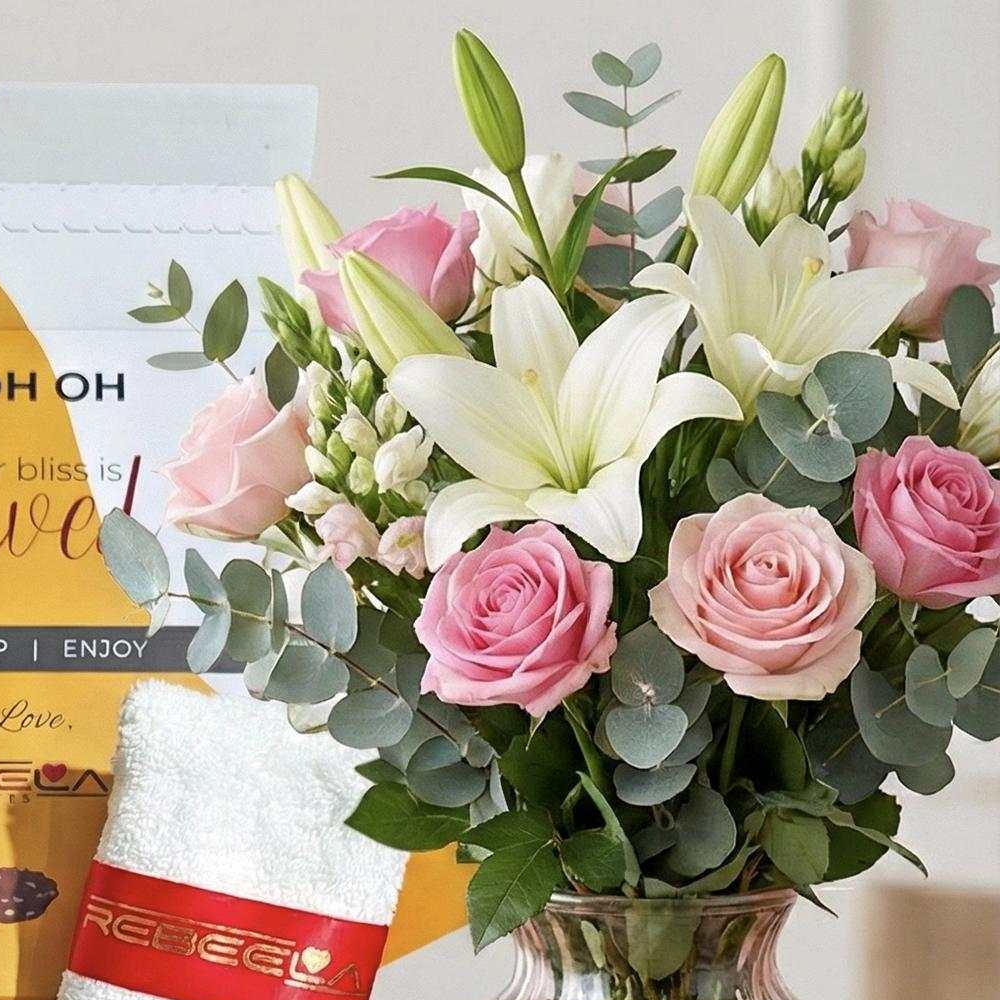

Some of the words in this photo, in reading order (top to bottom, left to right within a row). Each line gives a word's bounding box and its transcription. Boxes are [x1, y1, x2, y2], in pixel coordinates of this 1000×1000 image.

[55, 372, 125, 401] OH
[18, 457, 88, 482] bliss
[100, 457, 122, 482] is
[63, 639, 149, 659] ENJOY
[83, 904, 362, 991] REBEELA
